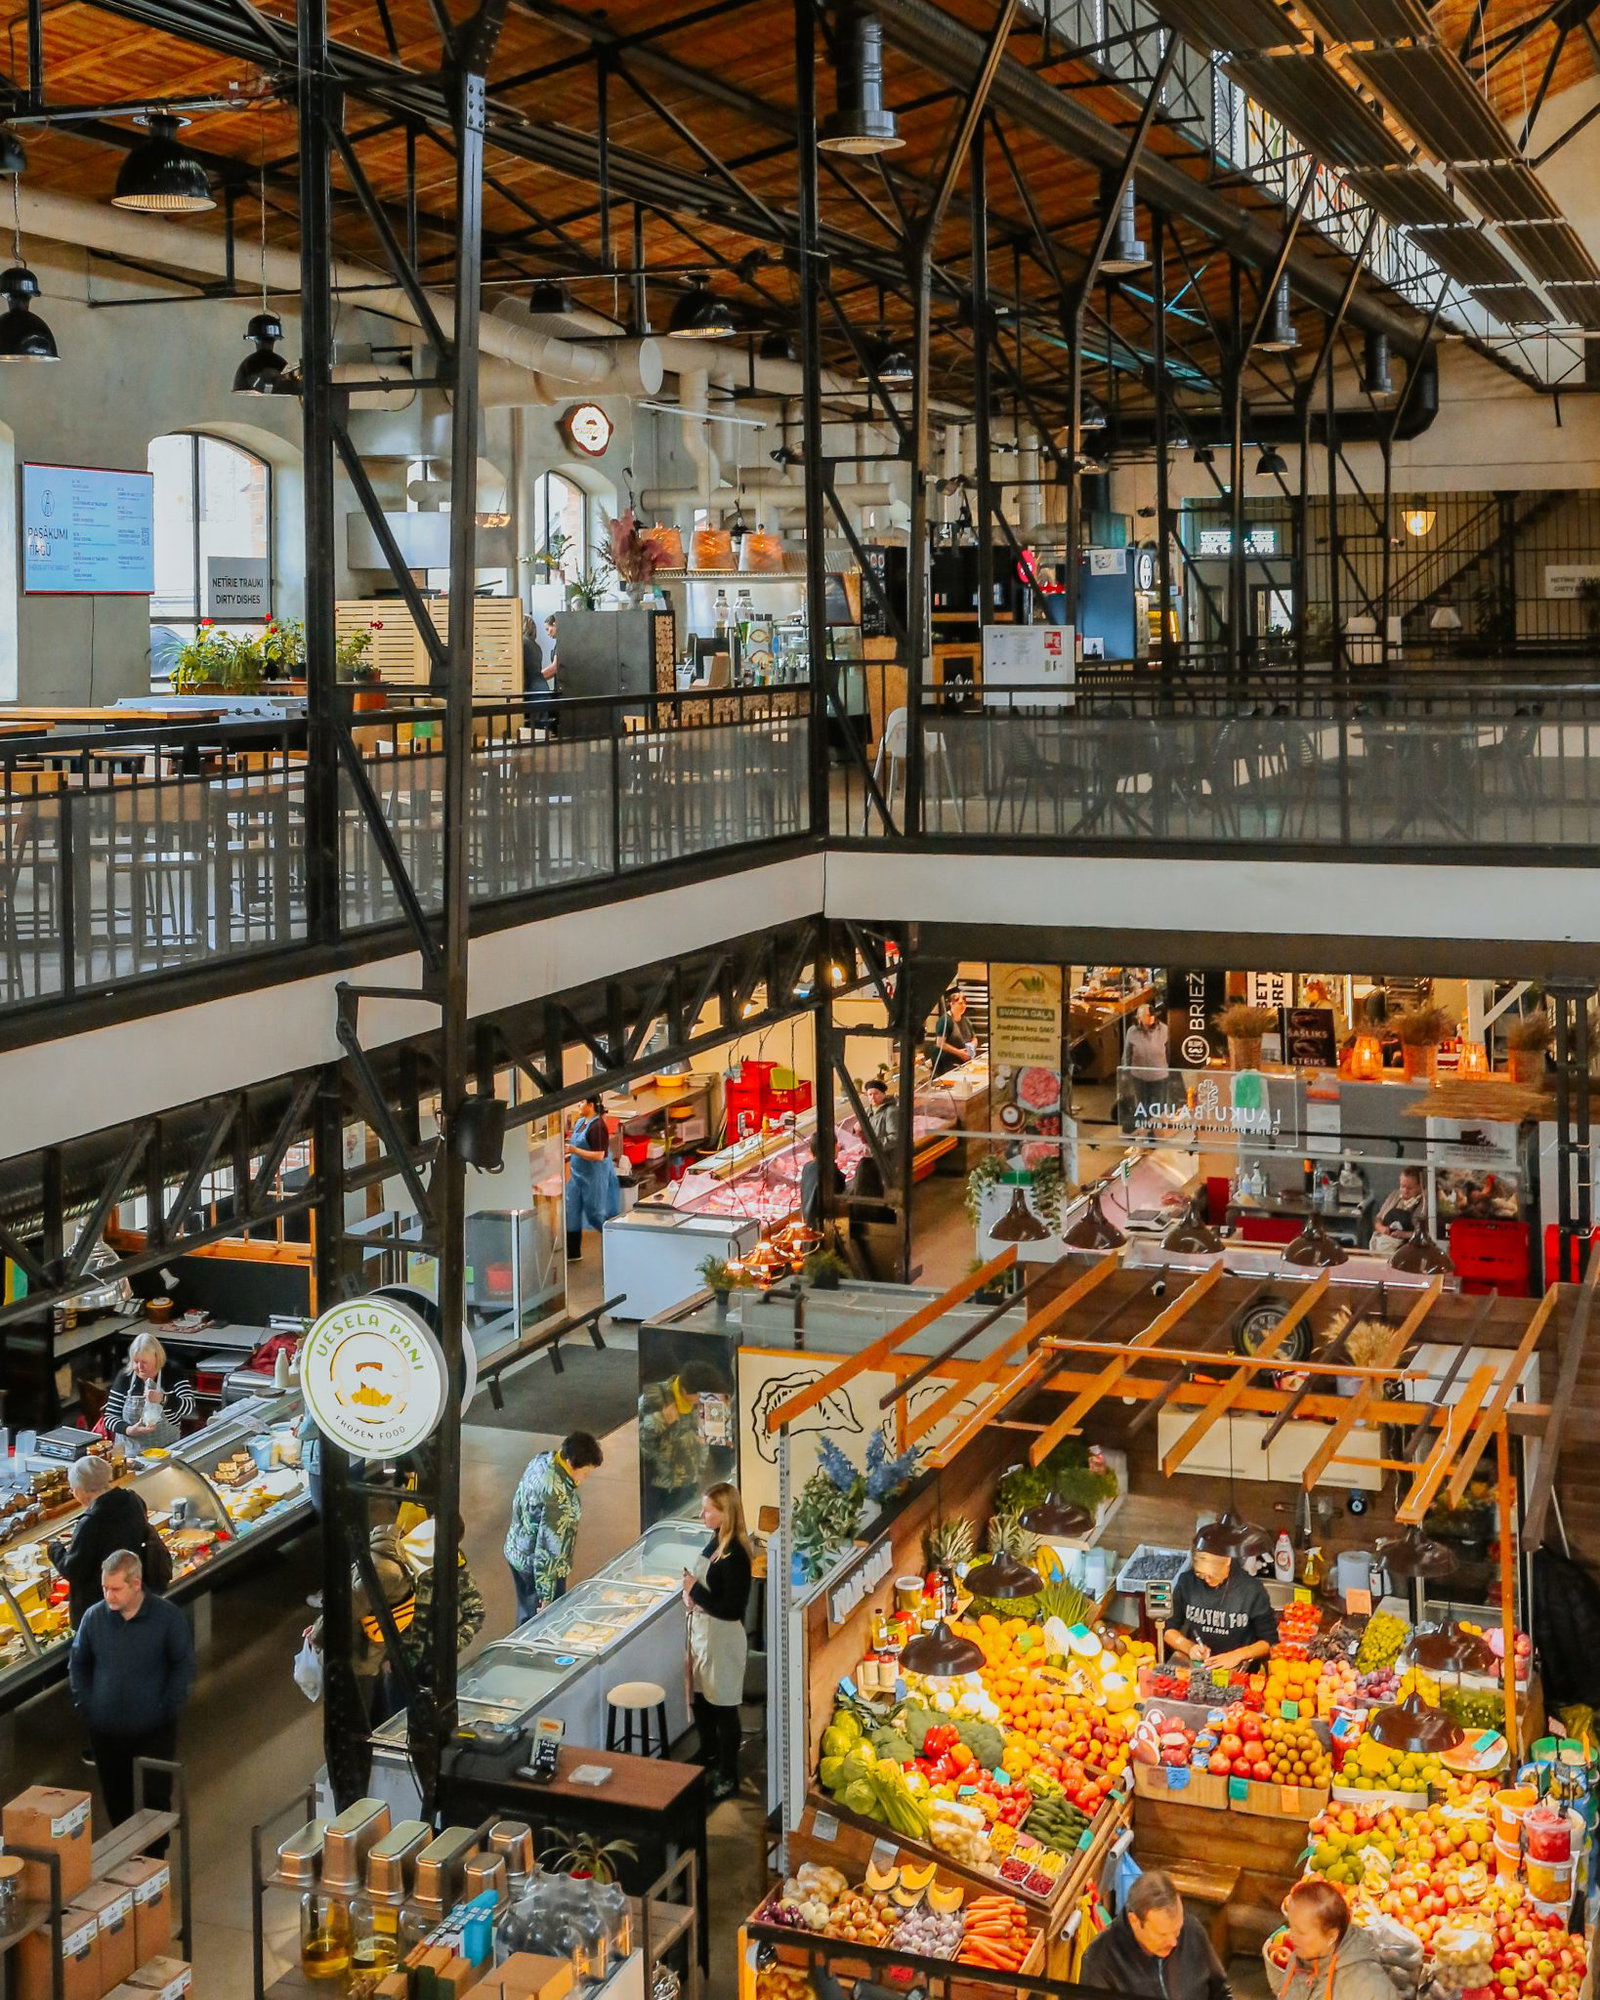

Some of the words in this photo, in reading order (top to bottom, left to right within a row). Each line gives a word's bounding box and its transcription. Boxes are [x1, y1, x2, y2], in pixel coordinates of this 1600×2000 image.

[28, 525, 69, 540] PASĀKUMI
[212, 575, 238, 588] NETĪRIE
[239, 578, 264, 588] TRAUKI
[216, 594, 236, 604] DIRTY
[237, 594, 261, 604] DISHES
[1185, 972, 1205, 1030] BRIEŽ
[1291, 1057, 1327, 1066] STEIKS
[389, 1323, 424, 1371] PANI
[336, 1415, 374, 1440] FROZEN
[379, 1426, 406, 1440] FOOD
